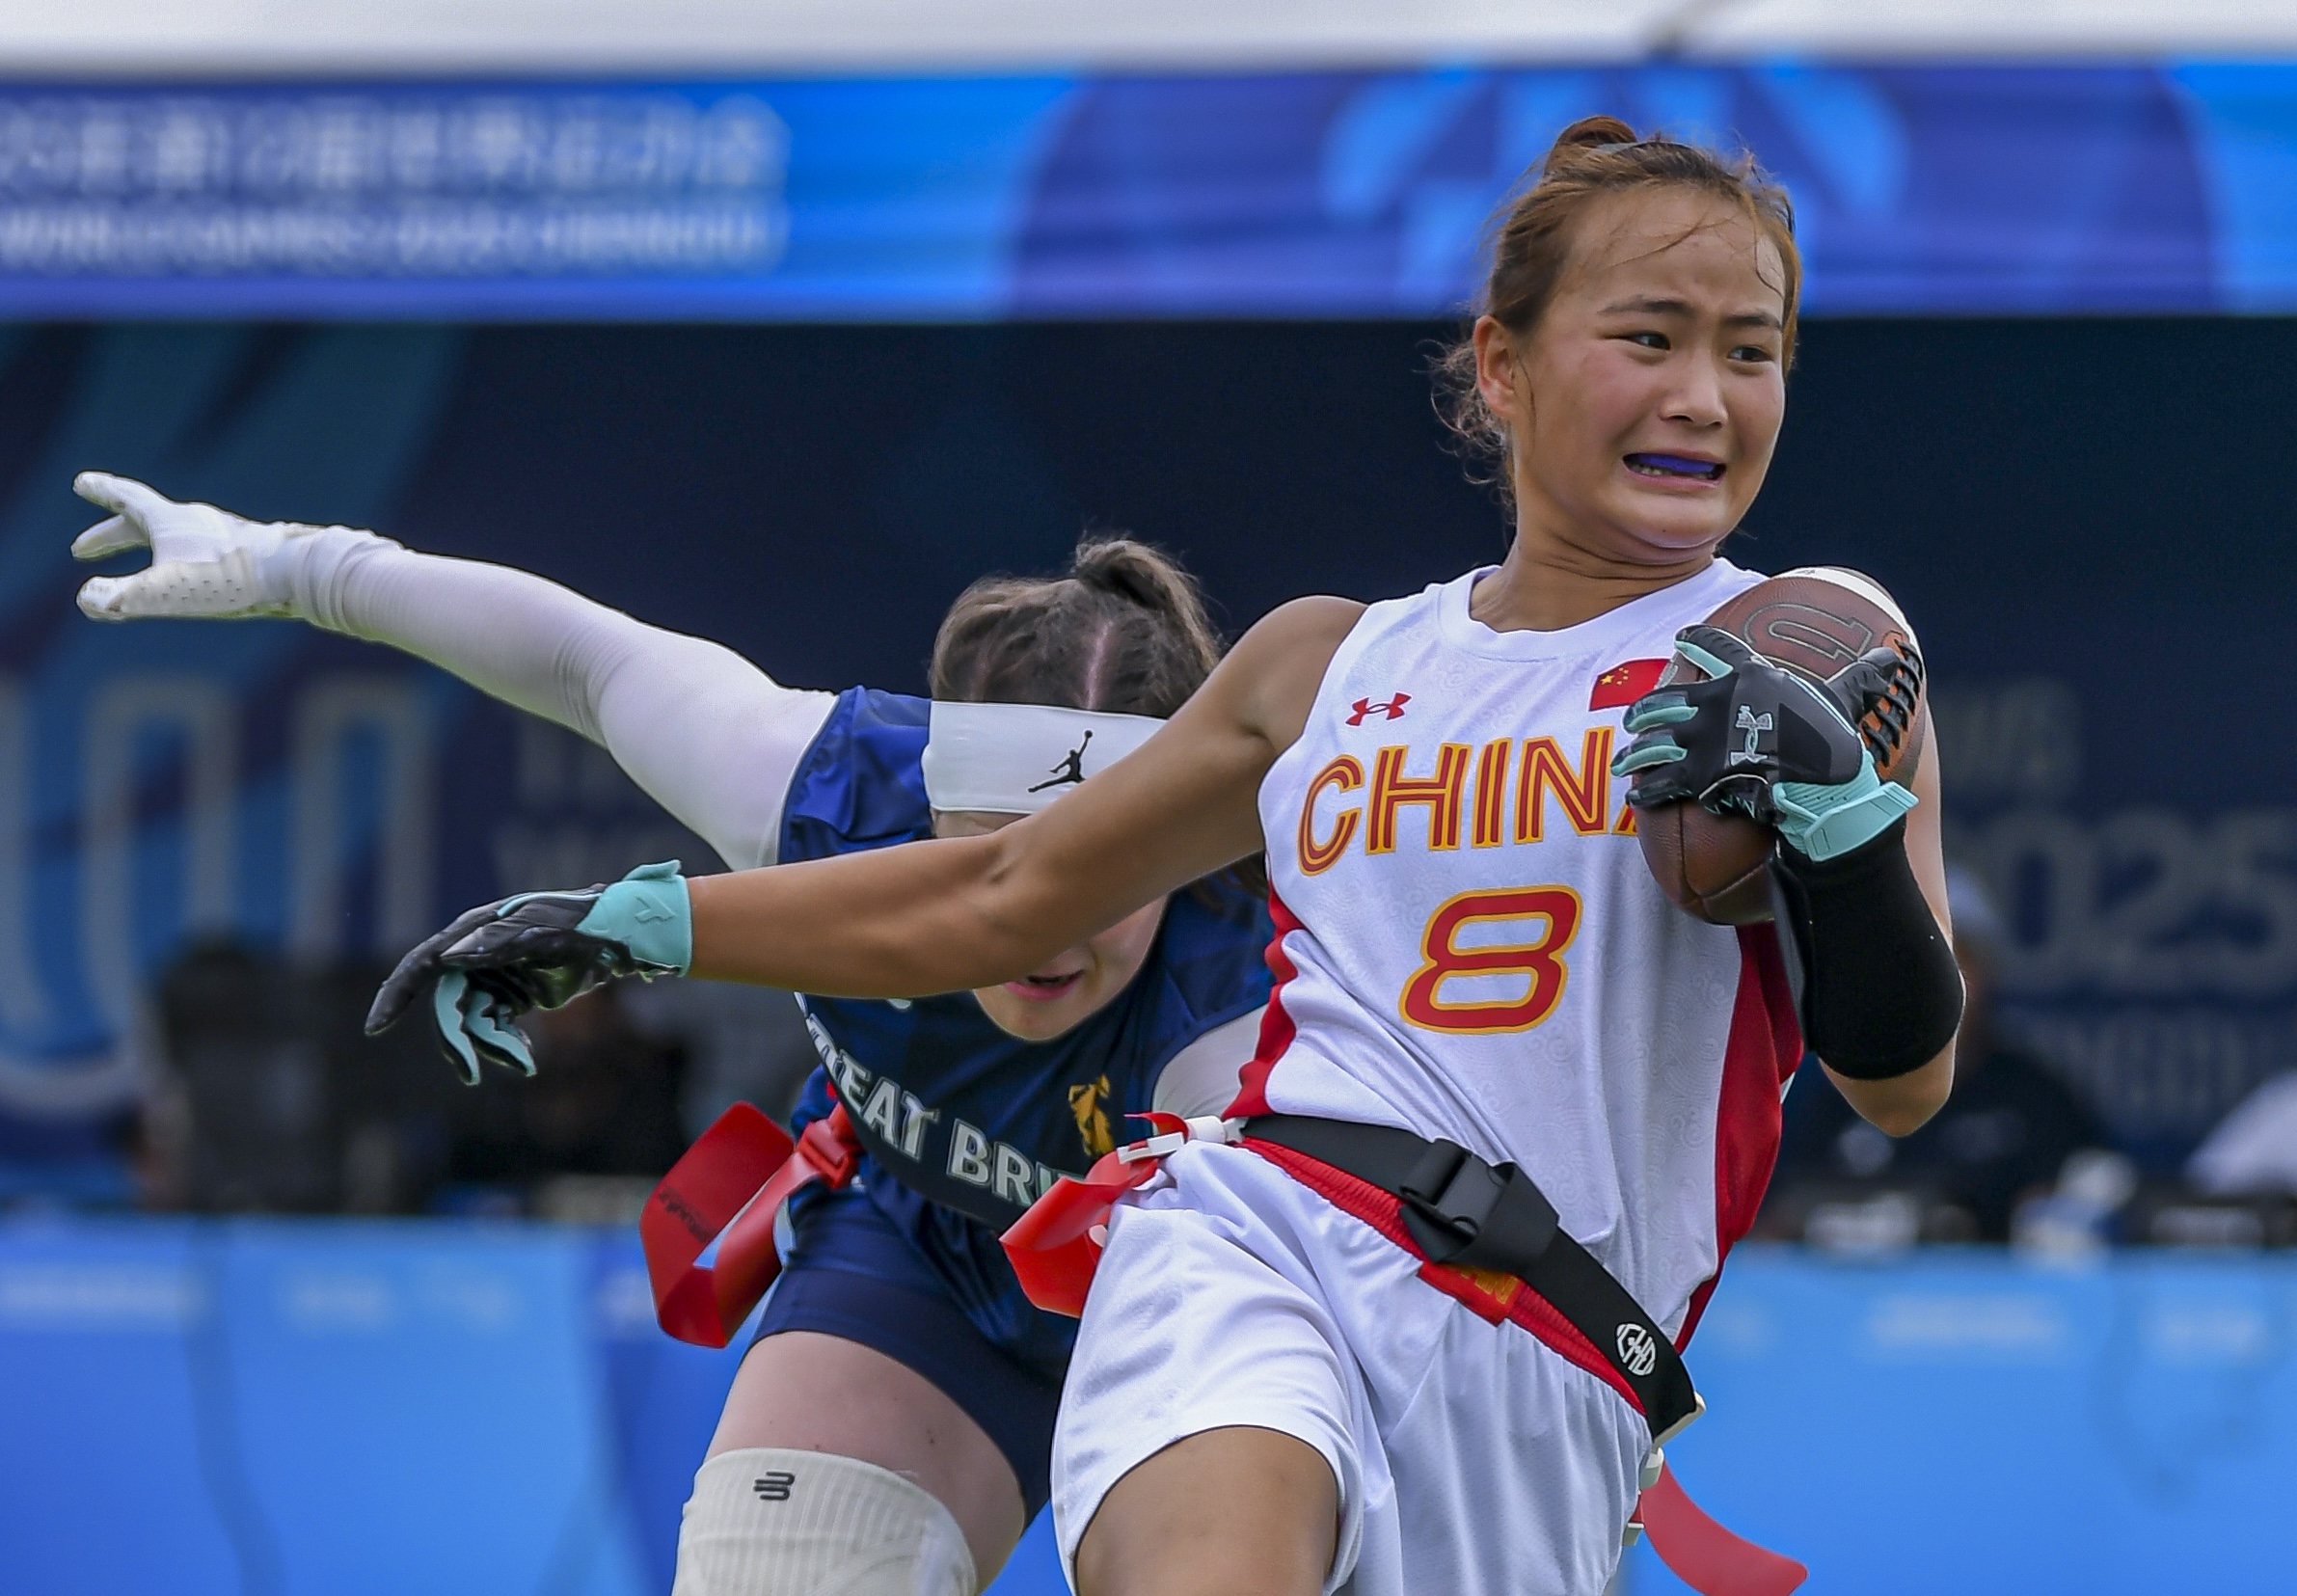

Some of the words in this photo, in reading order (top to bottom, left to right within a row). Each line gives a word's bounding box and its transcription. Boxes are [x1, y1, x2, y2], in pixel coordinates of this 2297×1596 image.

[1297, 725, 1639, 877] CHIN
[1399, 884, 1583, 1036] 8
[946, 1118, 1085, 1207] BRI
